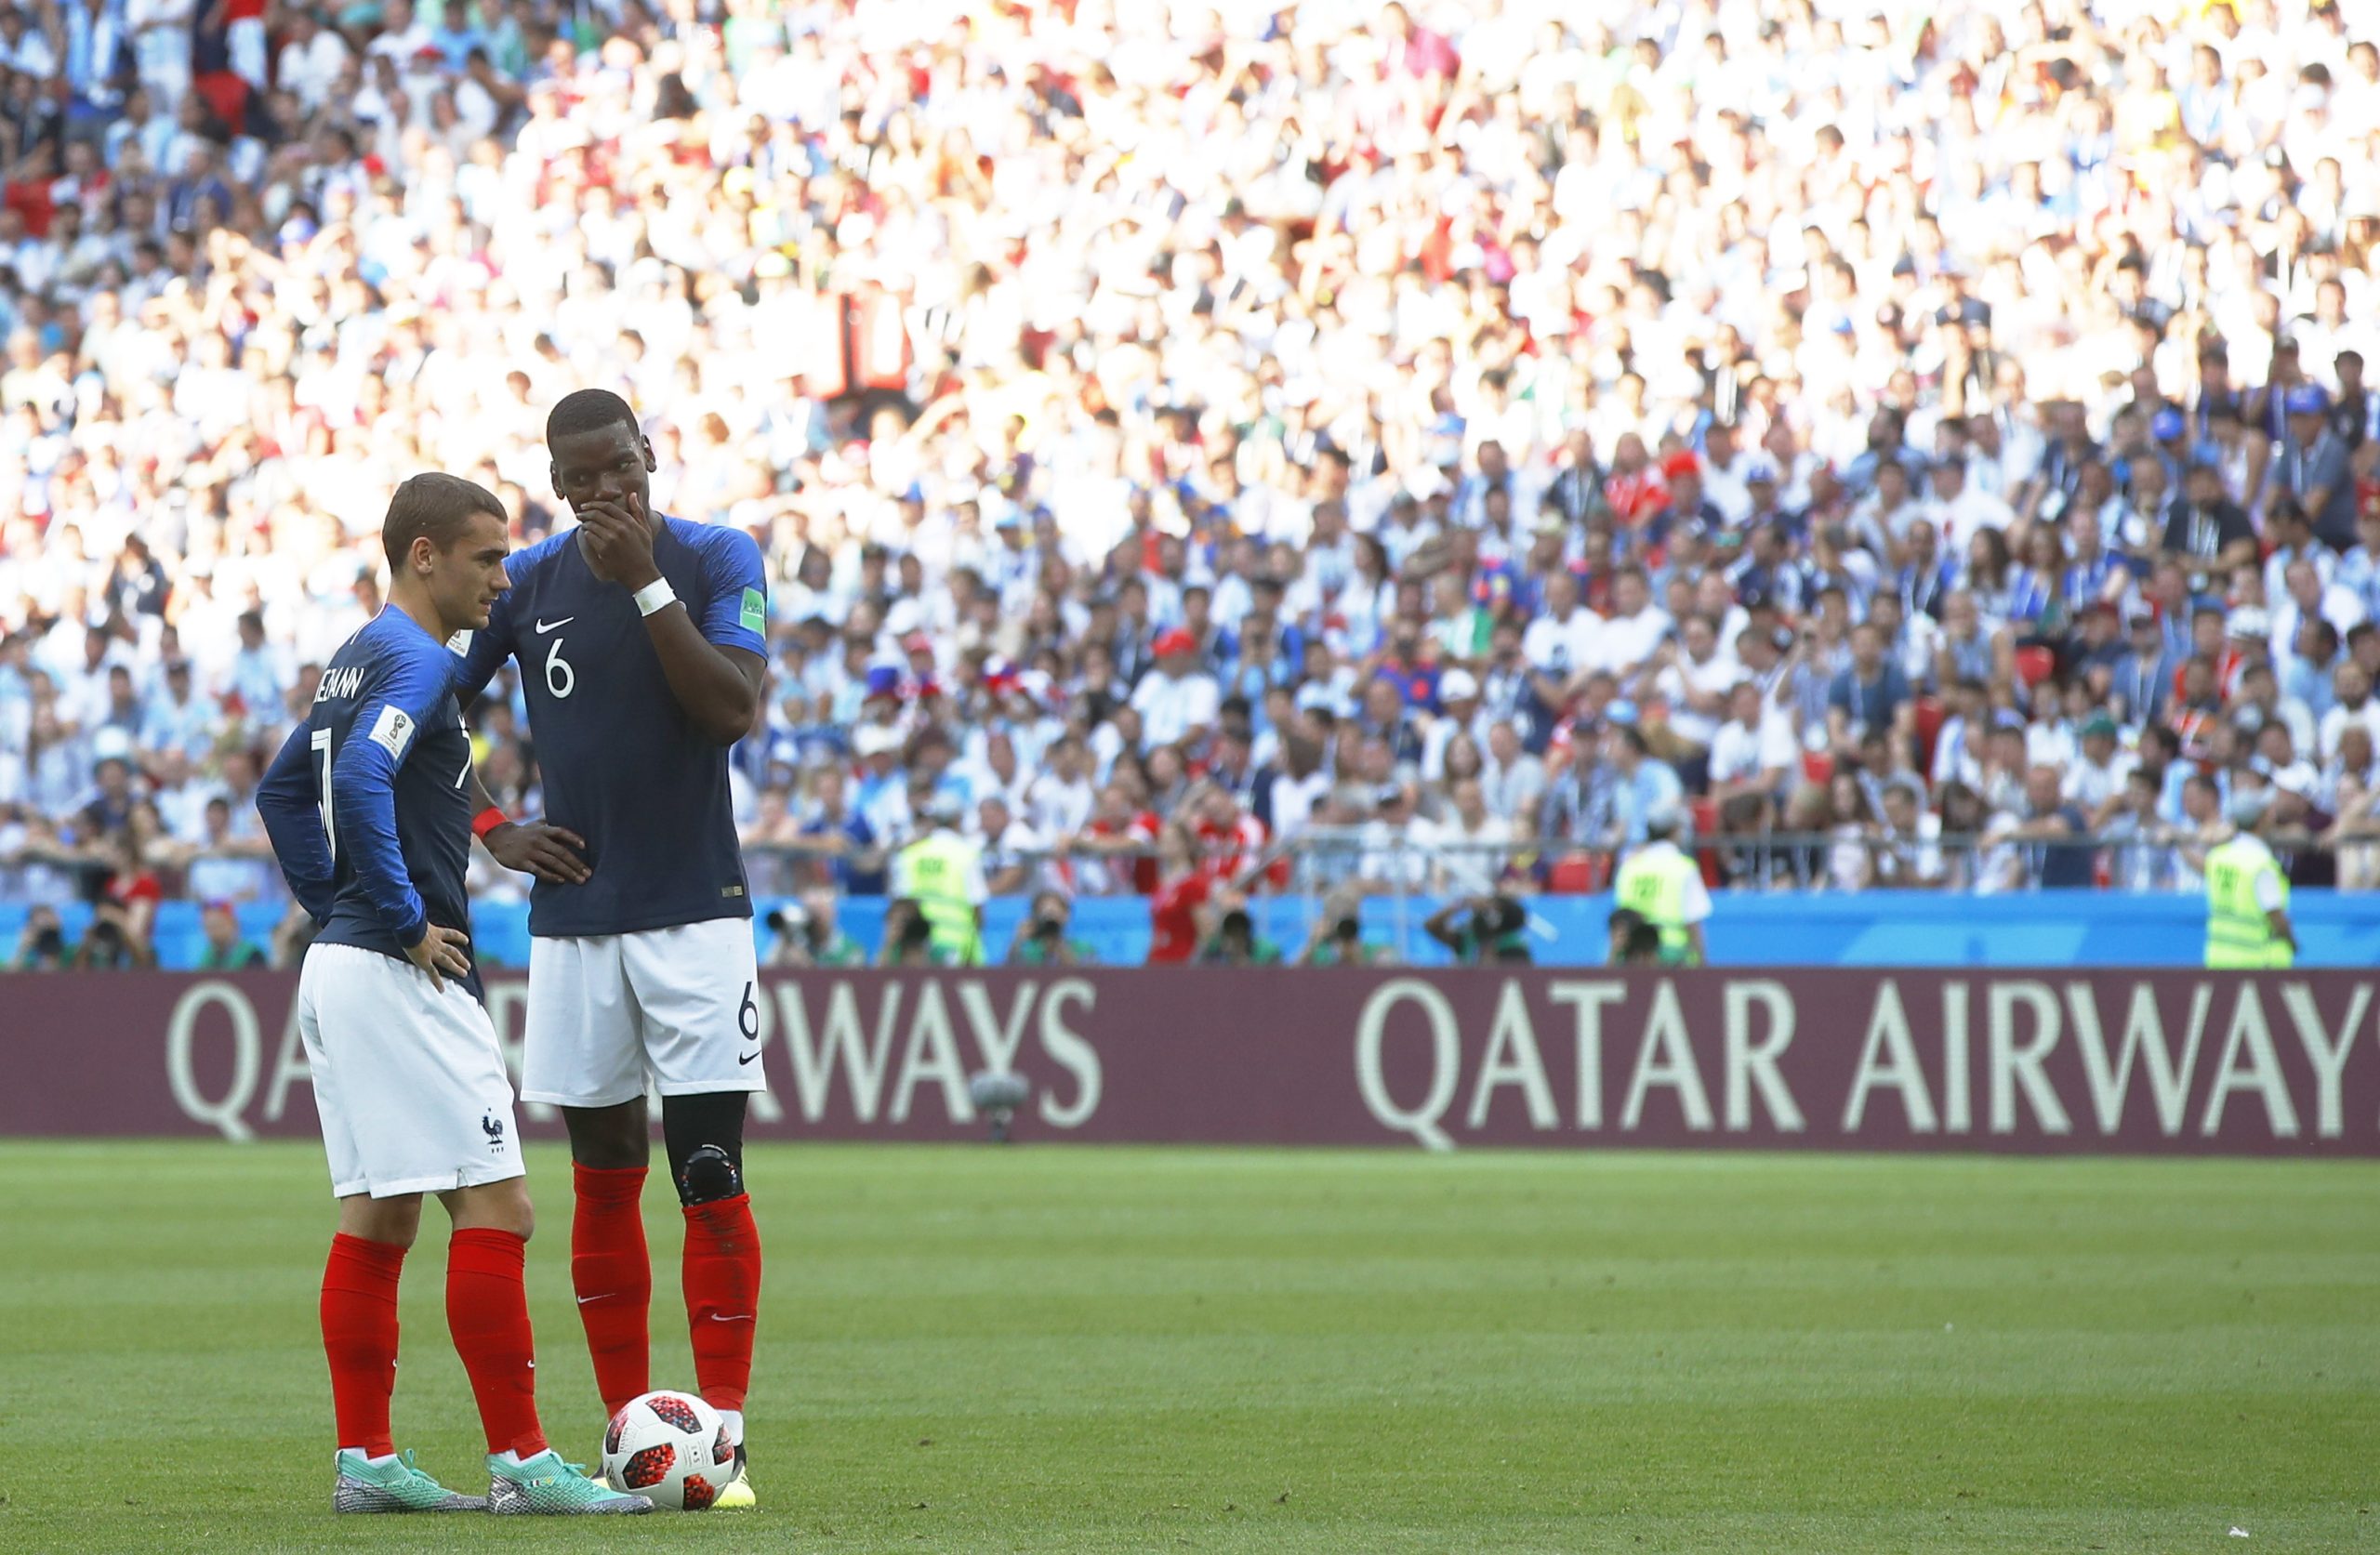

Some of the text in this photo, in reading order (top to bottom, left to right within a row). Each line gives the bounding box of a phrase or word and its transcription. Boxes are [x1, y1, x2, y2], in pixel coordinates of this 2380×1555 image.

[546, 638, 575, 699] 6
[738, 981, 760, 1041] 6
[749, 979, 1103, 1128] WAYS
[1355, 978, 2380, 1152] QATAR AIRWAY
